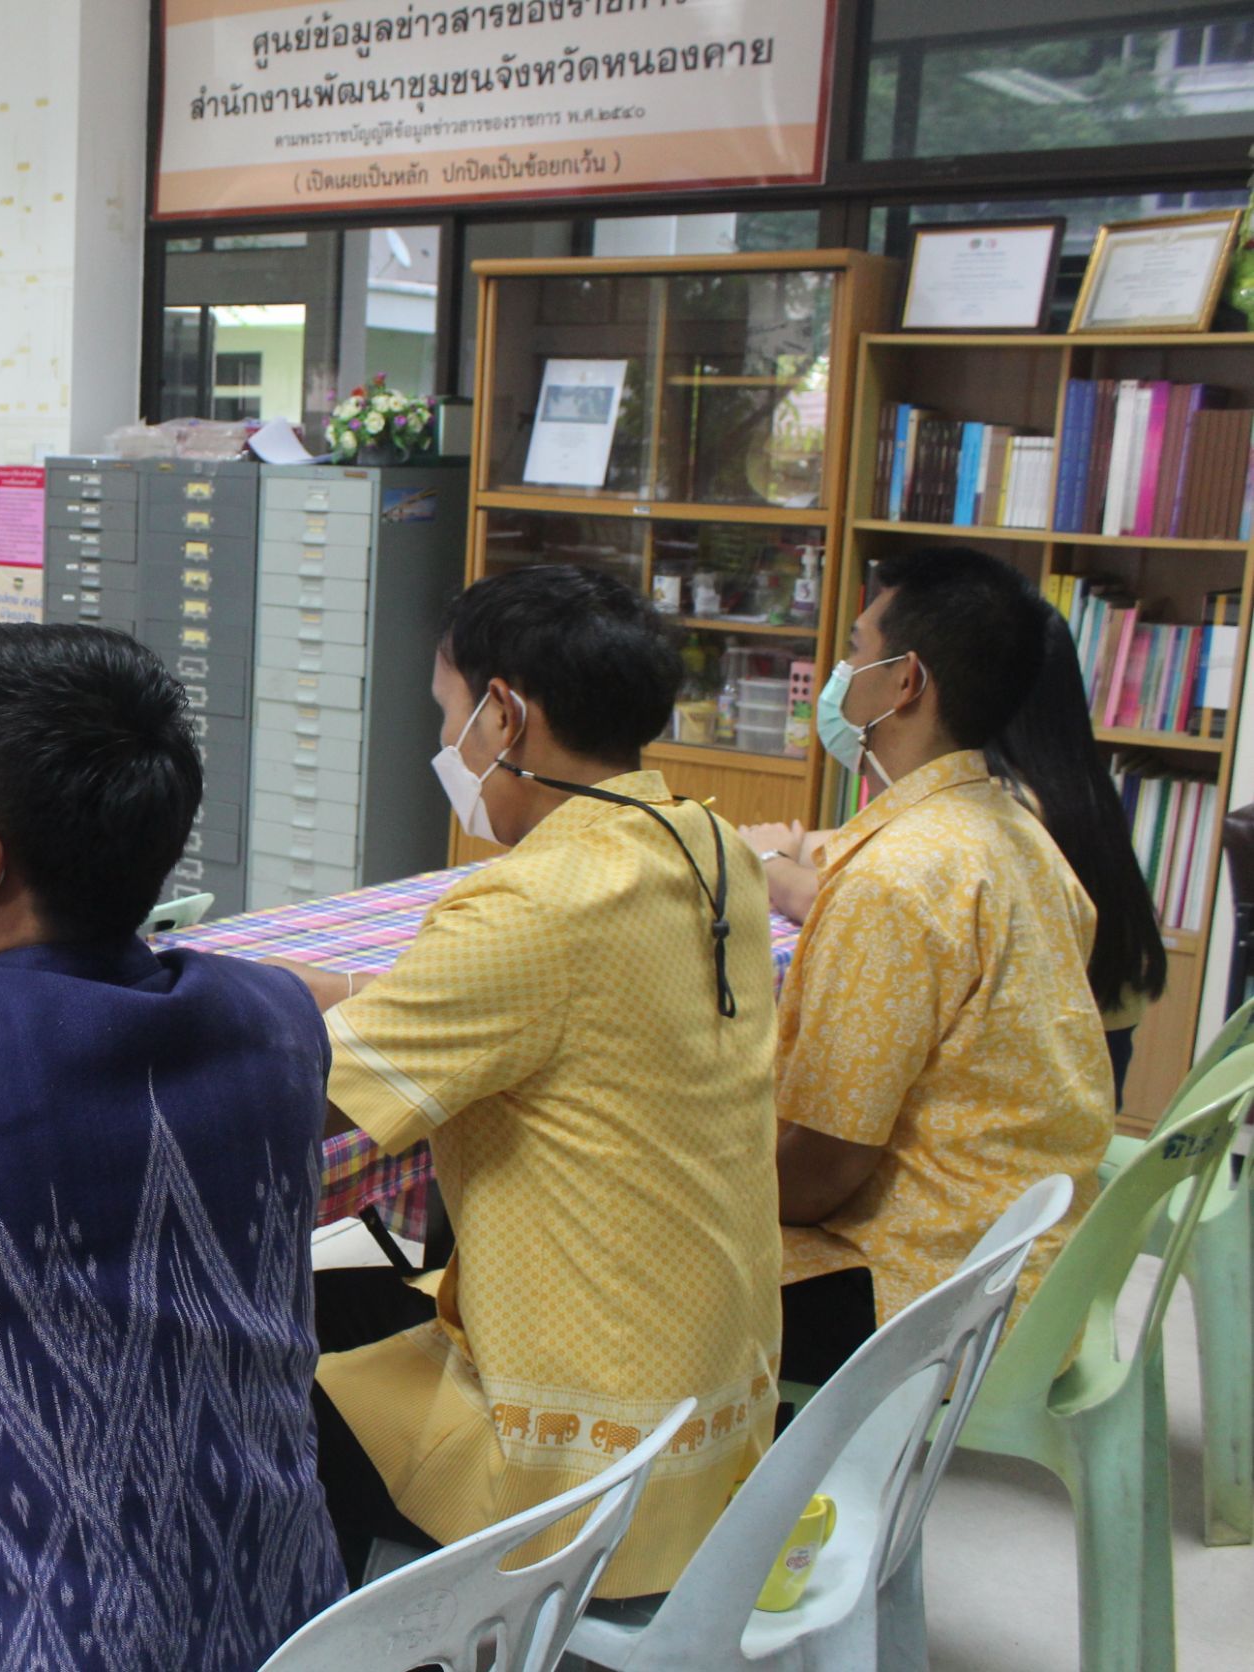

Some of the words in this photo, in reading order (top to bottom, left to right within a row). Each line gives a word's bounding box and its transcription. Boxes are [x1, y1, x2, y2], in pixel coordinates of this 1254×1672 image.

[190, 37, 774, 119] สำนักงานพัฒนาชุมชนจังหวัดหนองคาย
